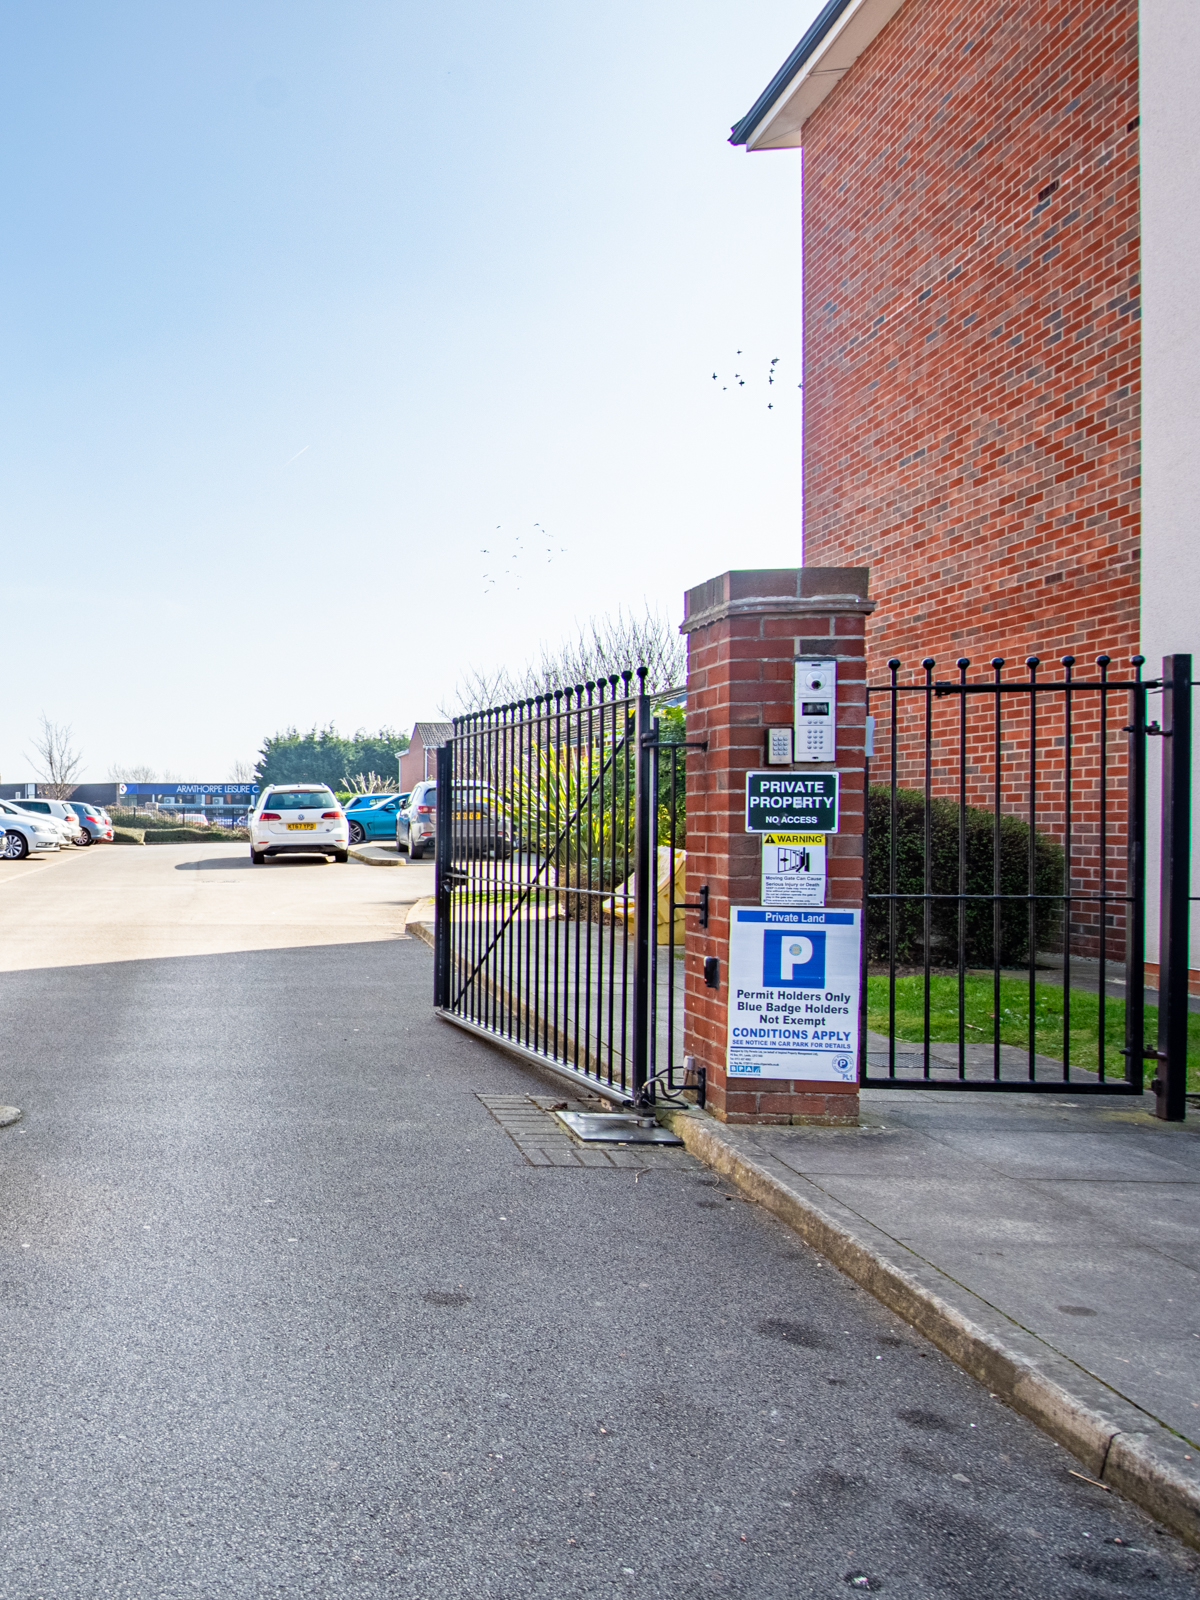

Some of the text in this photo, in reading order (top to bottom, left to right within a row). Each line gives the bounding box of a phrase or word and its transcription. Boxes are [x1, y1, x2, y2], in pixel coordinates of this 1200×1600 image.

[176, 785, 222, 793] ARMTHORPE
[224, 785, 250, 793] LEISURE
[760, 781, 824, 793] PRIVATE
[750, 796, 834, 808] PROPERTY
[765, 815, 779, 824] NO
[777, 835, 822, 843] WARNING
[765, 912, 825, 923] Private Land
[781, 936, 813, 980] P
[737, 989, 851, 1004] Permit Holders Only
[737, 1002, 849, 1014] Blue Badge Holders
[760, 1014, 826, 1028] Not Exempt
[732, 1027, 851, 1041] CONDITIONS APPLY
